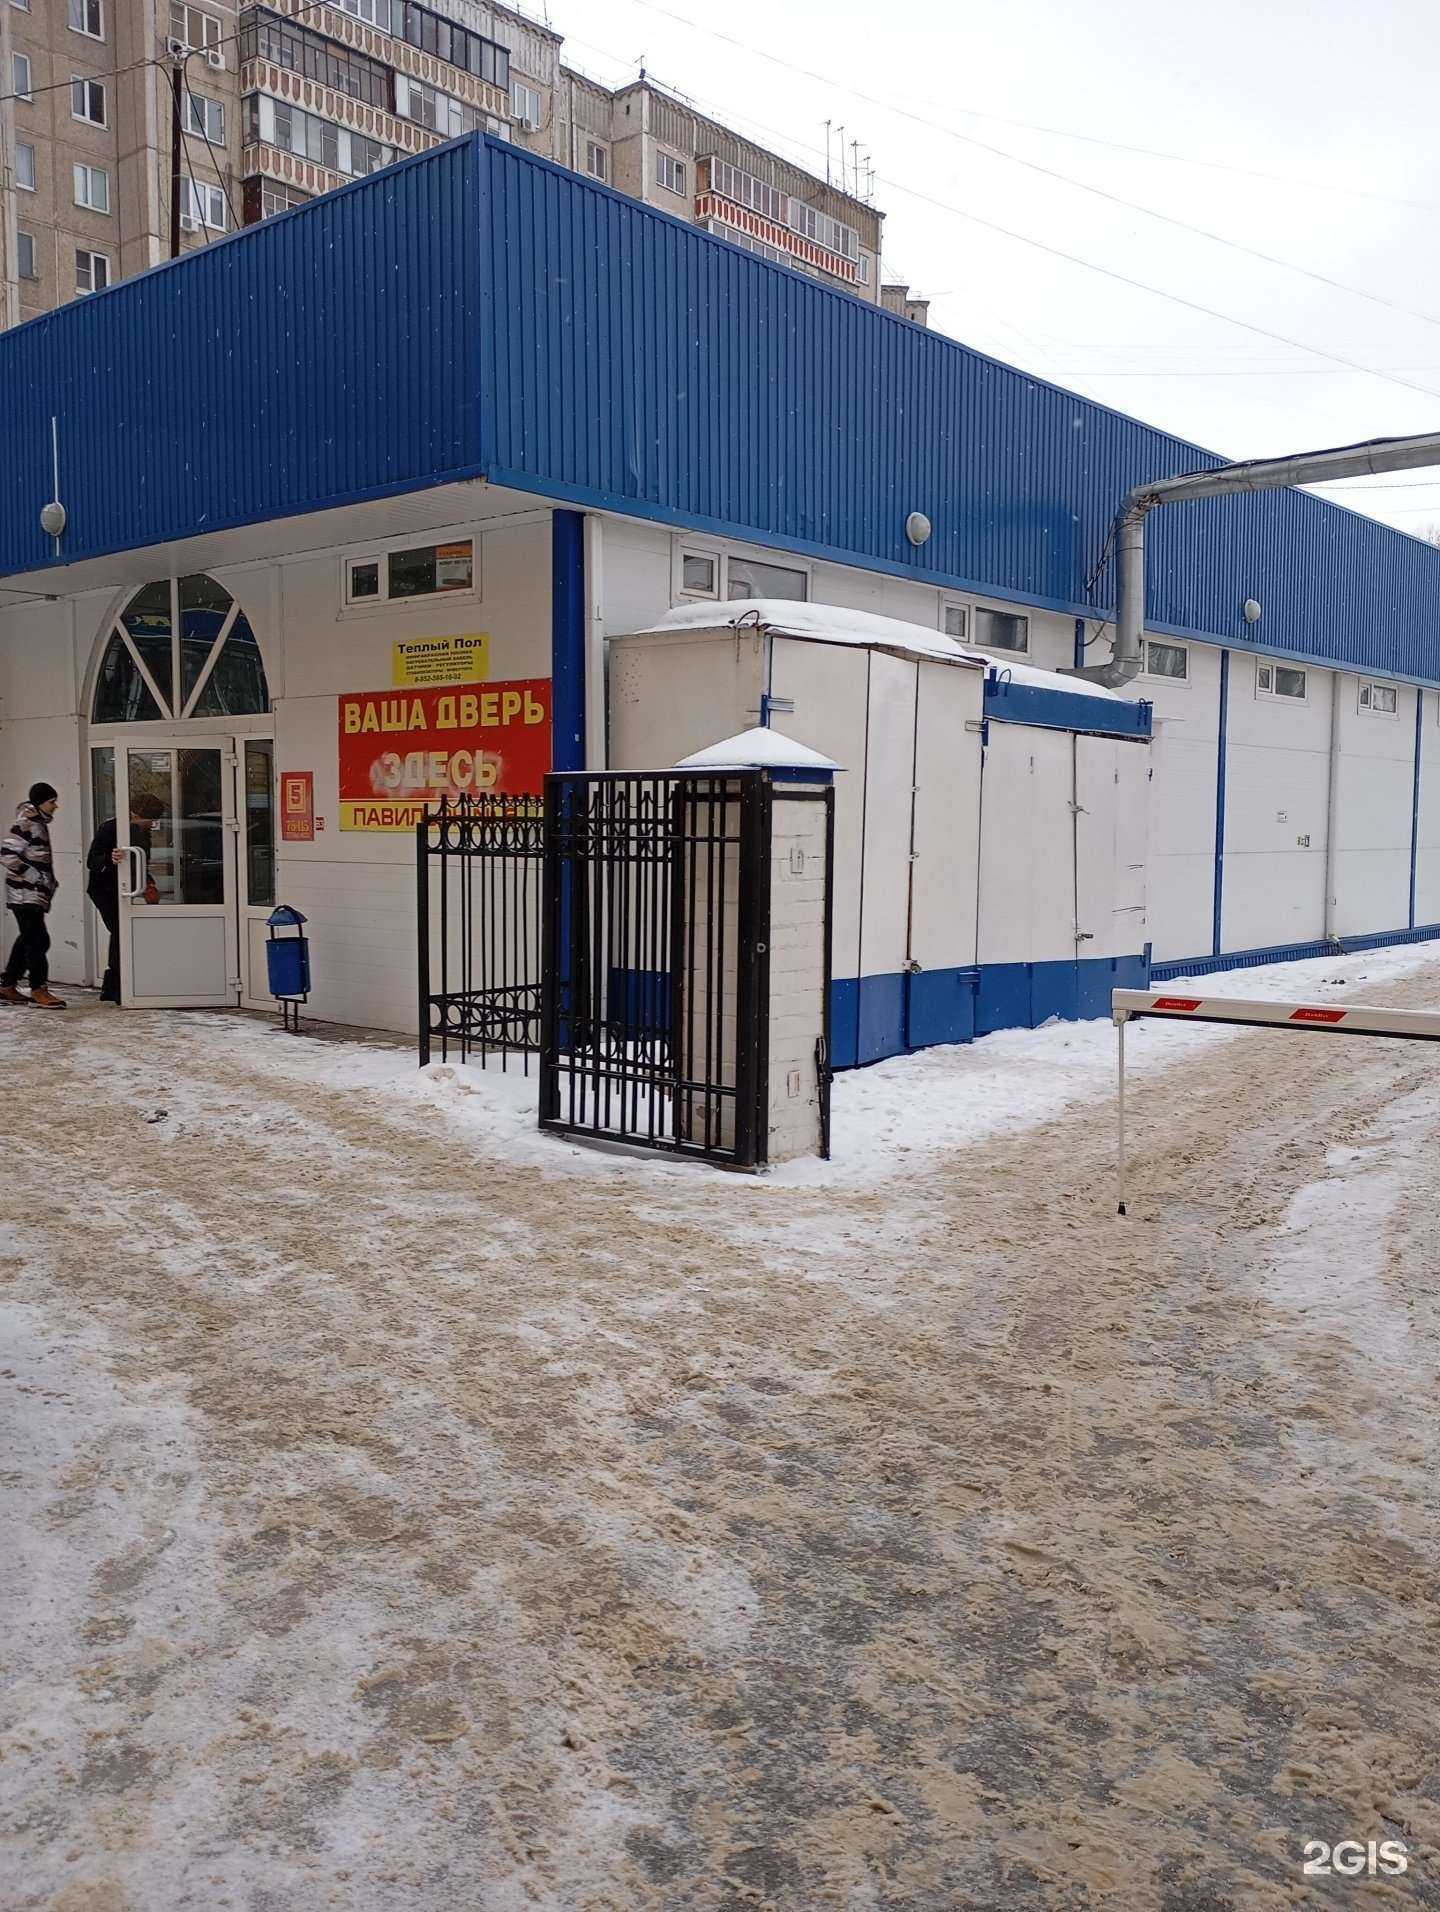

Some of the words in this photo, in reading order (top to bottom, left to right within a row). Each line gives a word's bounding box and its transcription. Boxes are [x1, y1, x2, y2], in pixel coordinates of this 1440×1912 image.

[398, 640, 449, 653] Теплый
[455, 639, 481, 648] Пол
[344, 699, 427, 734] ВАША
[436, 690, 545, 729] ДВЕРЬ
[383, 750, 497, 788] ЗДЕСЬ
[291, 784, 301, 805] 5
